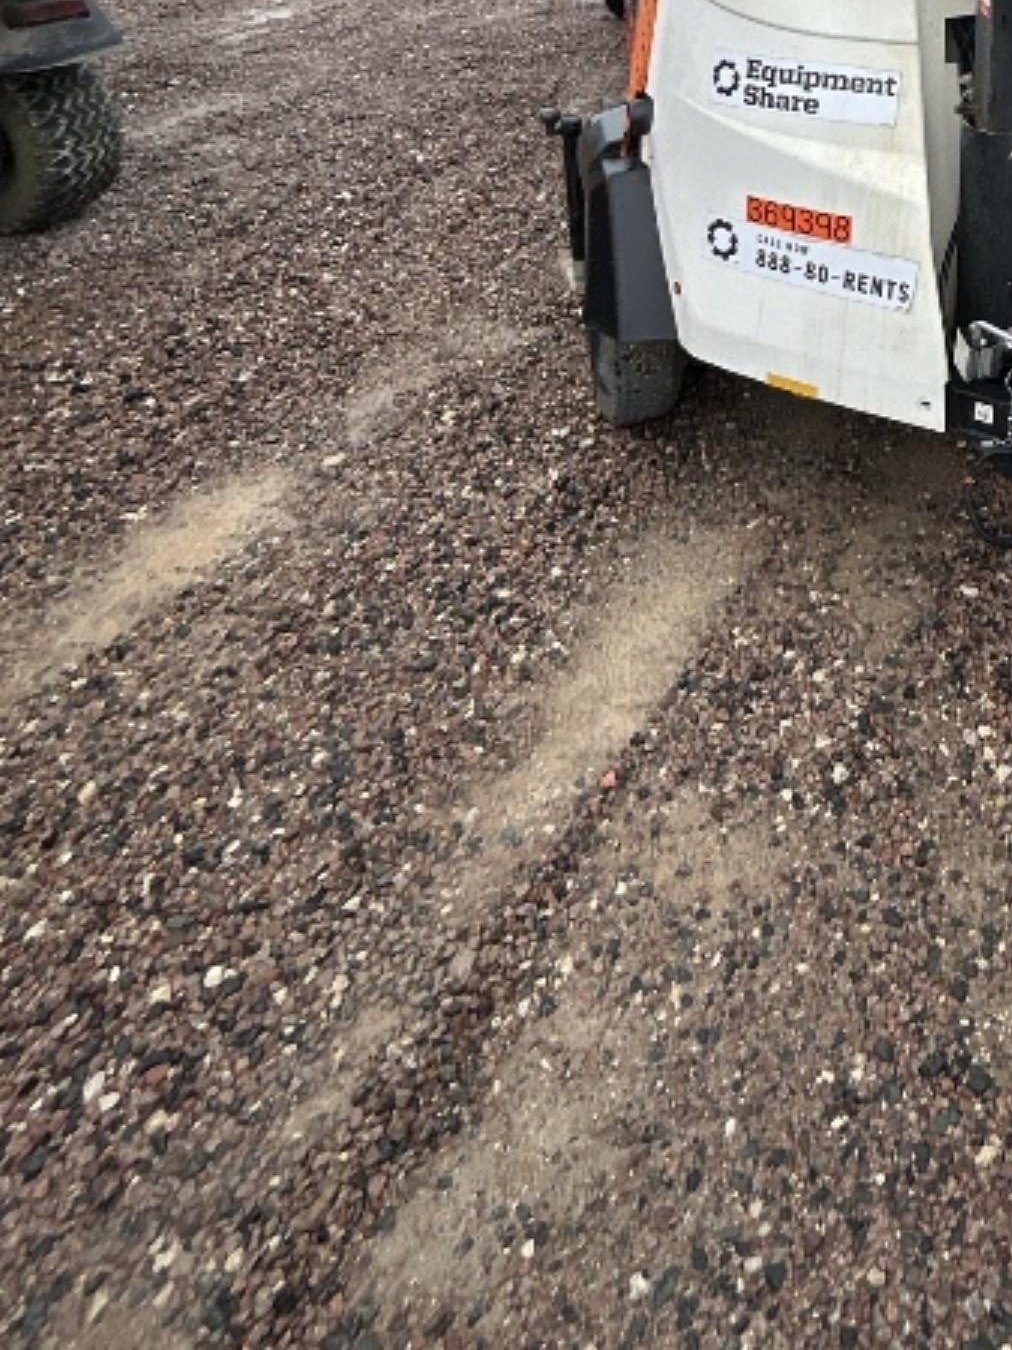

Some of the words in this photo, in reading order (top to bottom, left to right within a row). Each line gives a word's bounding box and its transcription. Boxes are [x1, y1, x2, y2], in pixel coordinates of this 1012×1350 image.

[745, 58, 898, 97] Equipment
[743, 83, 820, 115] Share
[748, 197, 851, 243] 369398
[755, 249, 910, 304] 888-80-RENTS
